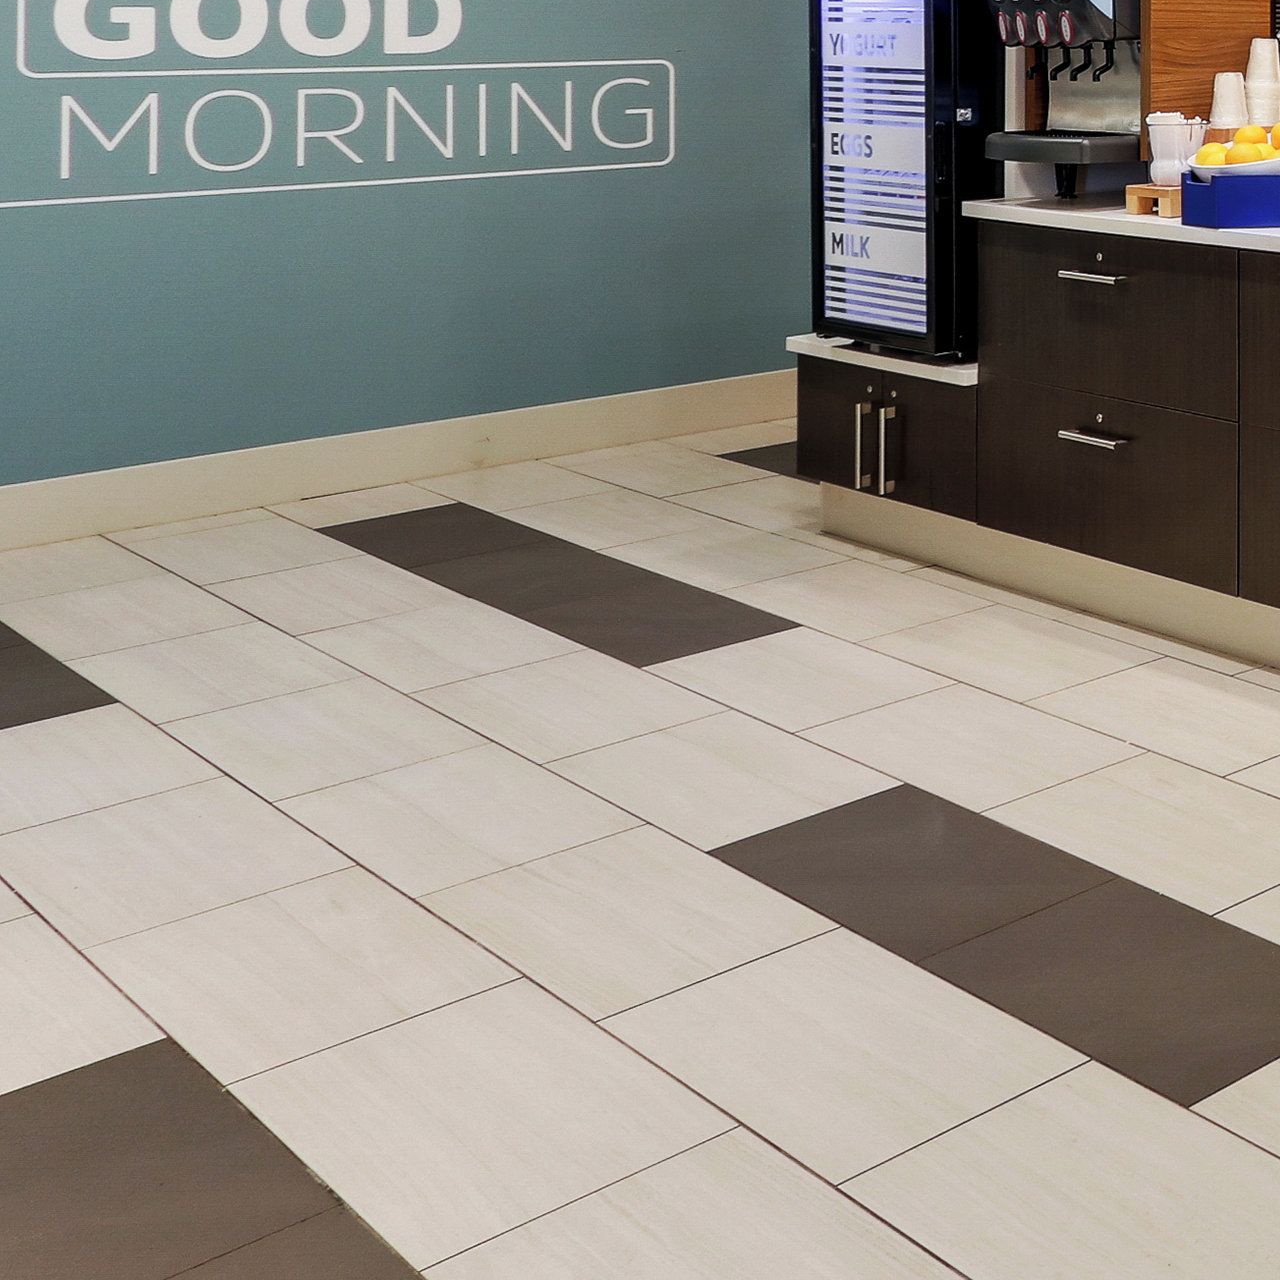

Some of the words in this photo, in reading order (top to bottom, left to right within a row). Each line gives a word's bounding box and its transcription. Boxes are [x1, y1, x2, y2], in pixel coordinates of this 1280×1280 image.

[59, 76, 656, 180] MORNING
[831, 132, 873, 158] EGGS
[831, 231, 871, 259] MILK
